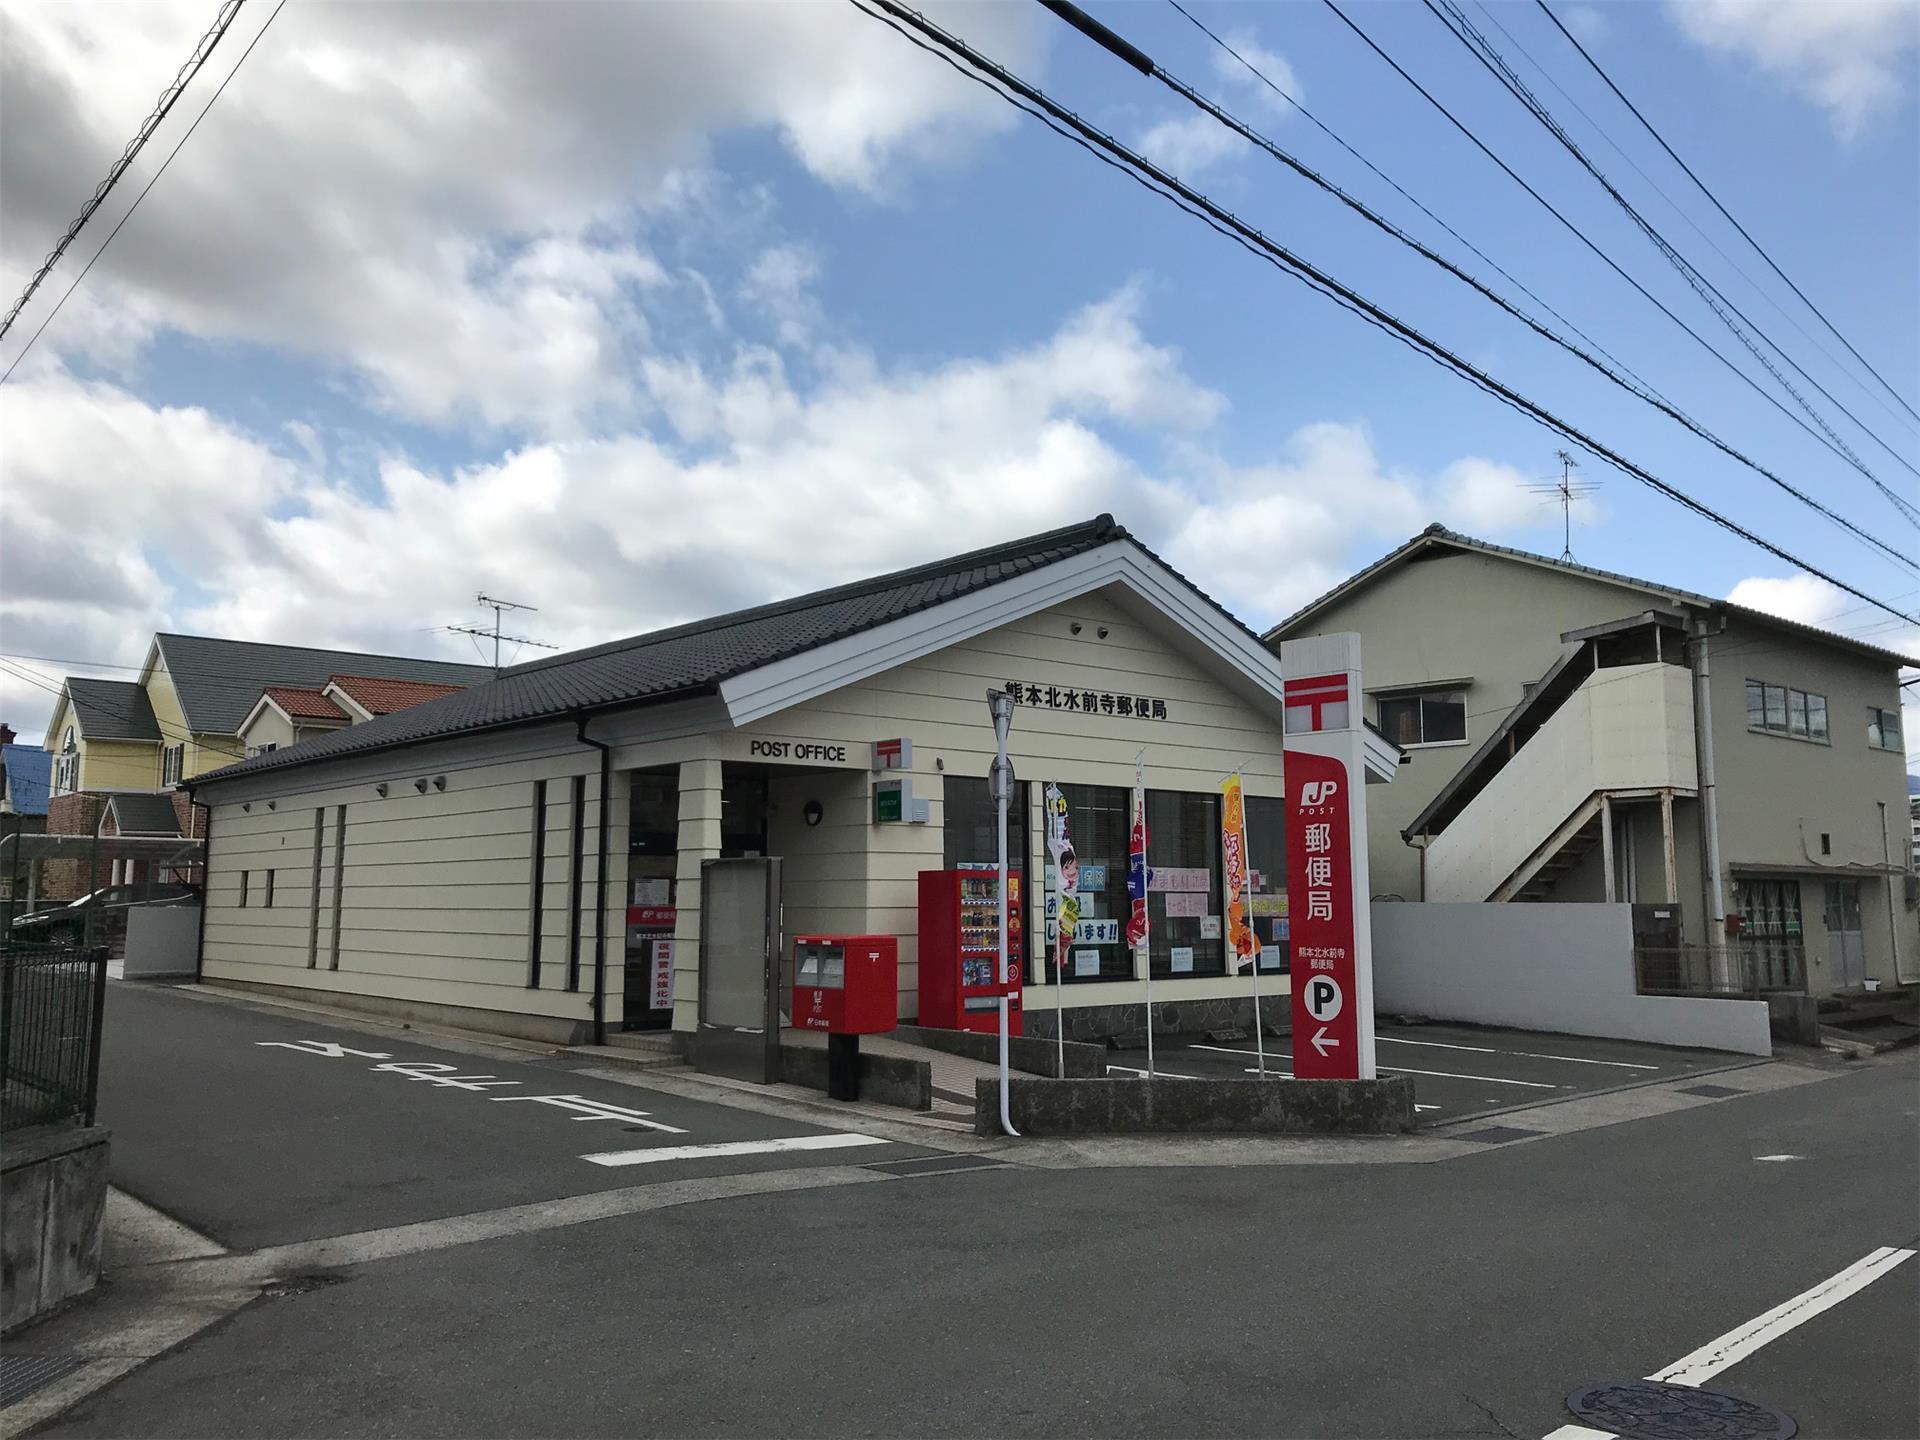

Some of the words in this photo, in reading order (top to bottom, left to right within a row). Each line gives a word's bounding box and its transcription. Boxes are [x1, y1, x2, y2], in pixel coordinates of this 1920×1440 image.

[751, 740, 791, 759] POST
[795, 743, 846, 763] OFFICE
[1299, 807, 1335, 815] POST
[1305, 823, 1332, 921] 郵便局
[1313, 982, 1335, 1015] P
